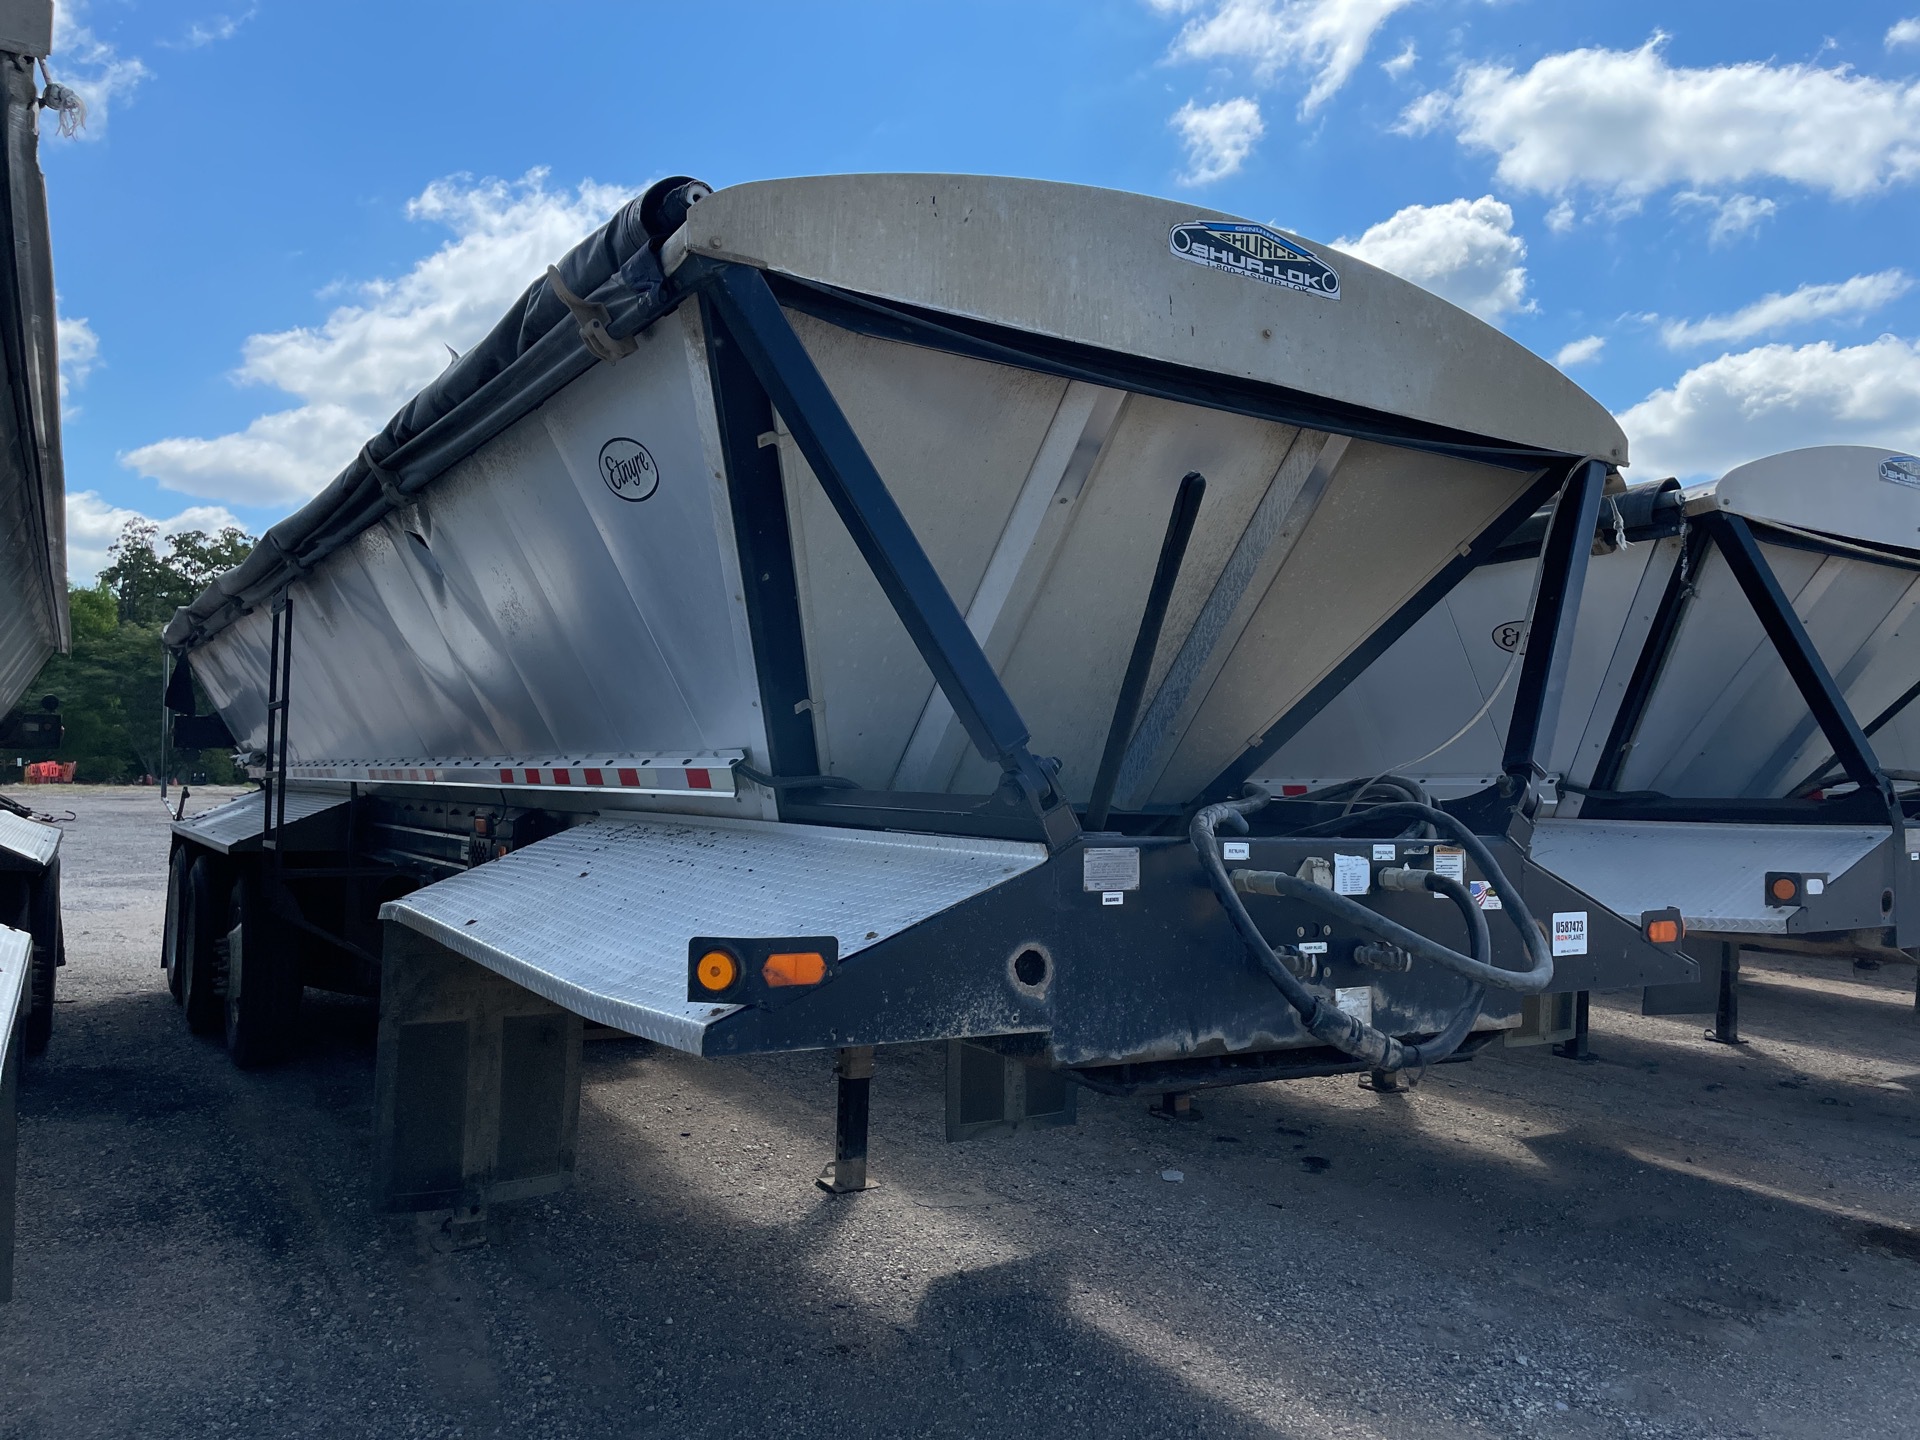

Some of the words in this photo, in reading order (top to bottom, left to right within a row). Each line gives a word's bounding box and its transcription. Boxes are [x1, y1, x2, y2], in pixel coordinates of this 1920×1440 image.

[1219, 233, 1298, 260] SHURCO
[1234, 226, 1281, 244] GENUINE
[1190, 242, 1321, 290] SHUR-LOK
[605, 451, 649, 490] Etnyre
[1555, 920, 1584, 933] U587473
